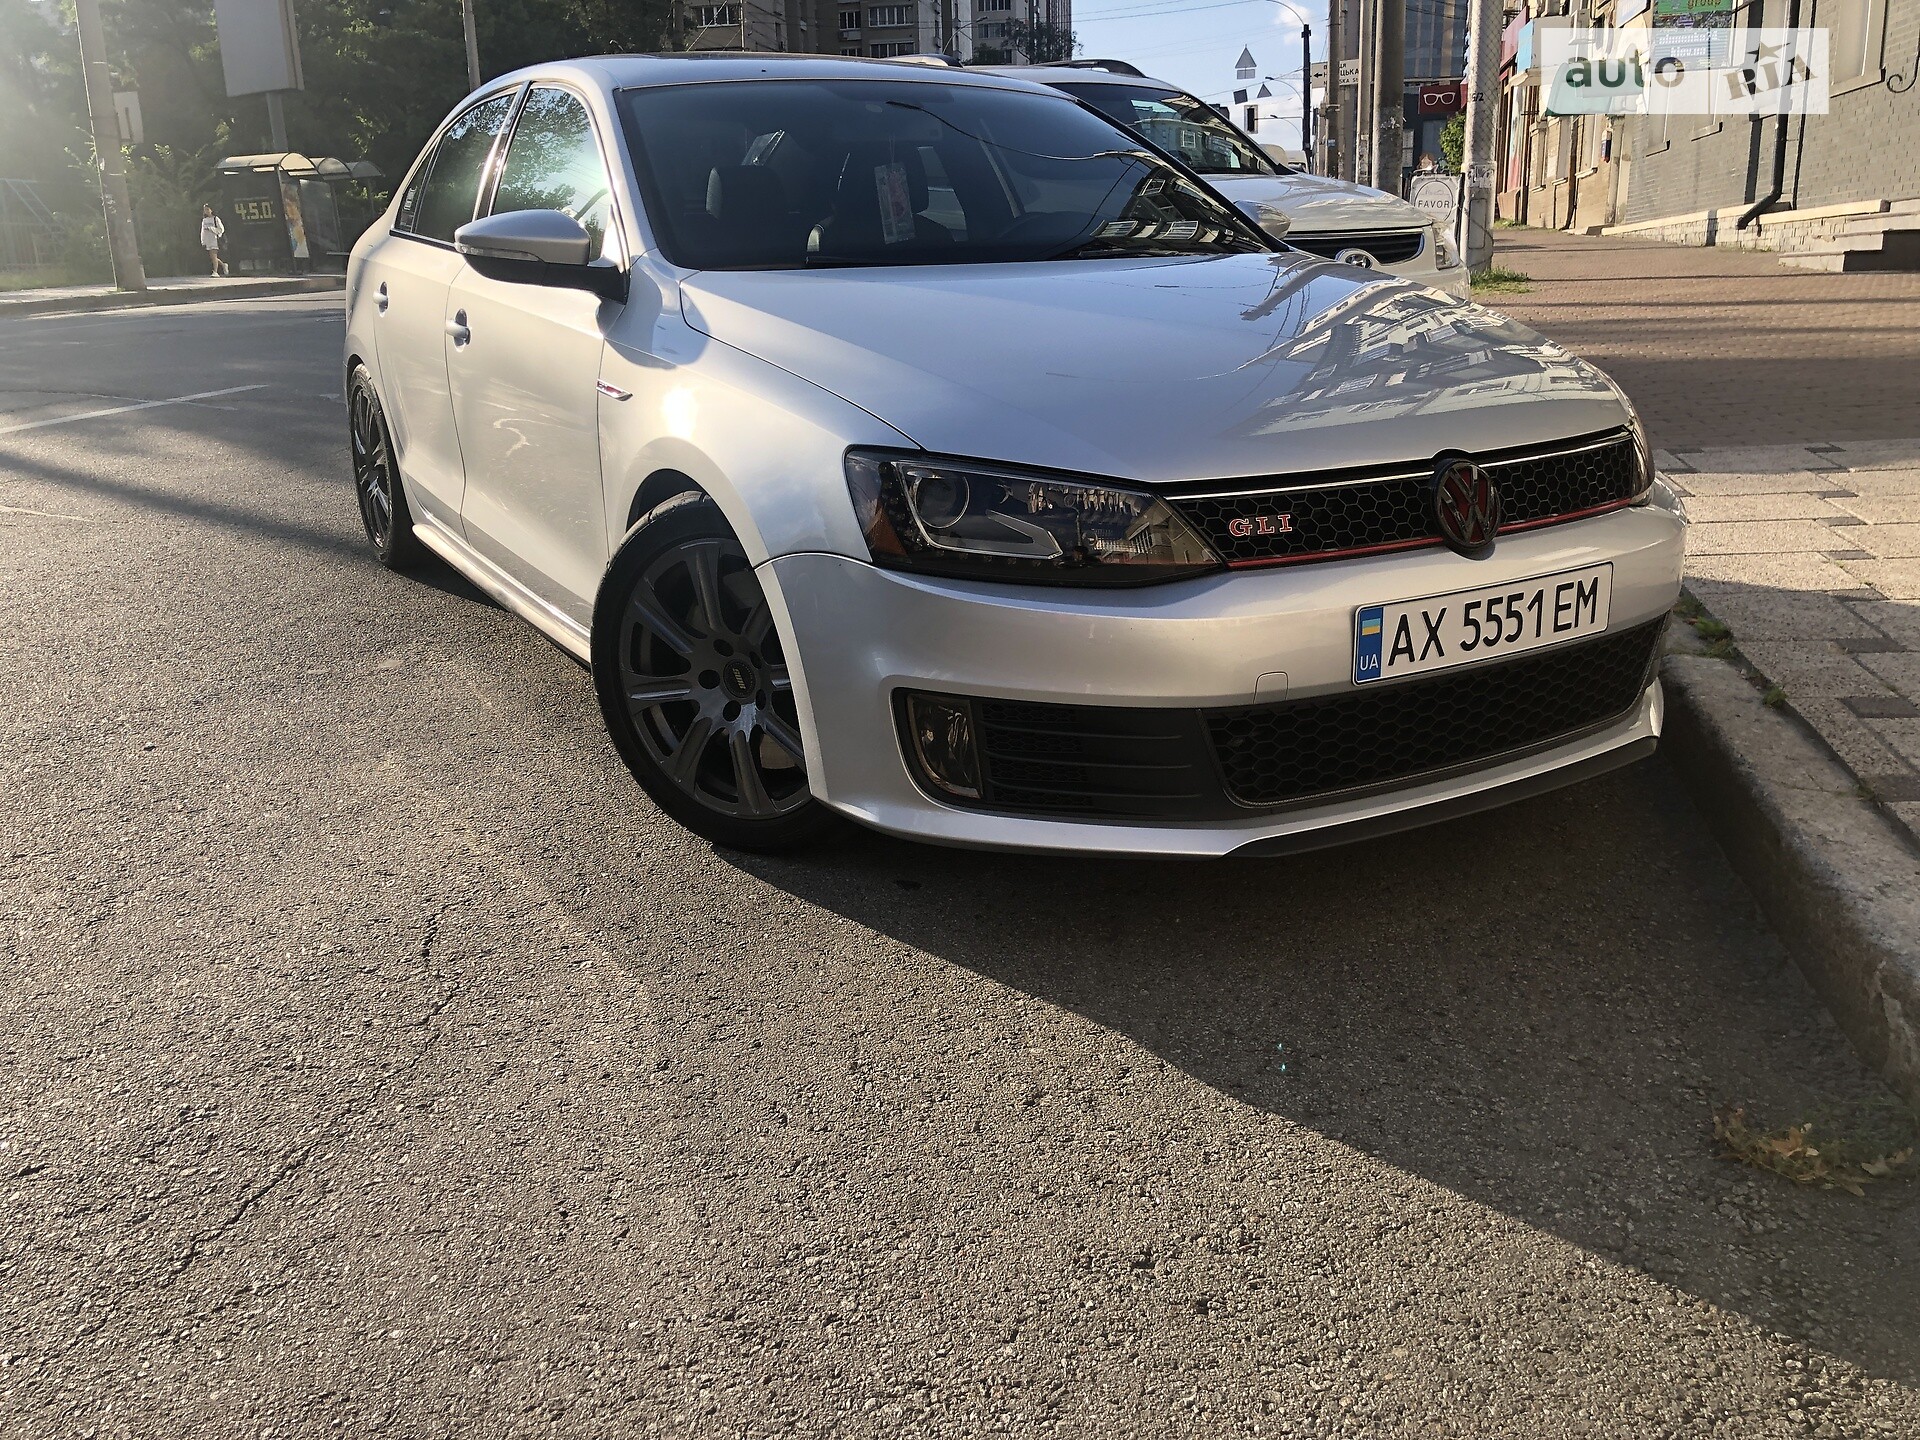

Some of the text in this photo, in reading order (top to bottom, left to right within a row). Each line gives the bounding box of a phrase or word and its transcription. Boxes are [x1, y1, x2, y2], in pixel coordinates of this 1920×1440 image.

[1418, 200, 1450, 208] FAVOR
[1229, 514, 1292, 536] GLI
[1388, 577, 1598, 666] AX 5551 EM
[1360, 654, 1378, 671] UA
